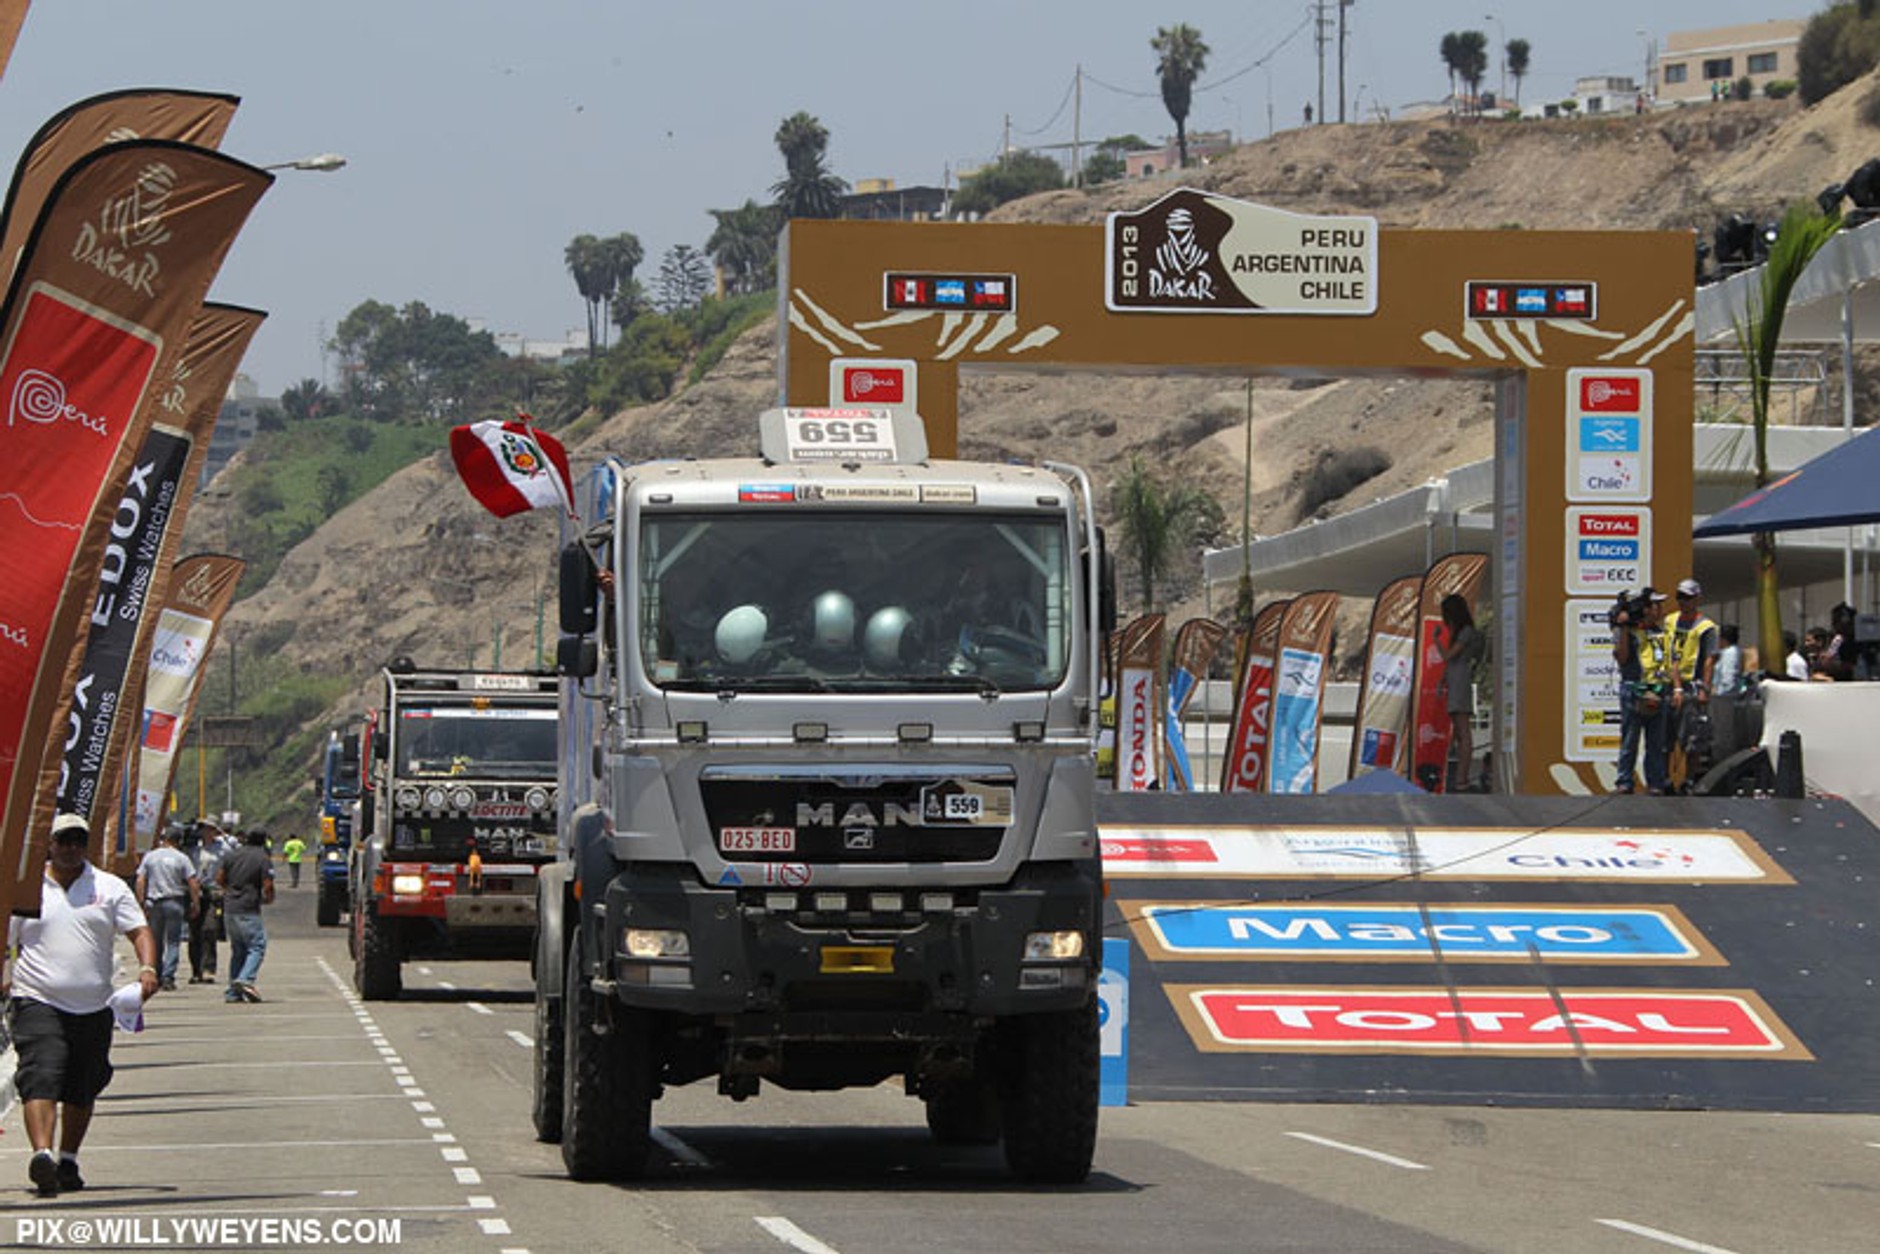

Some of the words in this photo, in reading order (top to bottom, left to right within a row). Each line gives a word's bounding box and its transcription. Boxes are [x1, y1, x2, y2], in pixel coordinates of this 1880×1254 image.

[1301, 230, 1365, 248] PERU
[72, 221, 159, 297] DAKAR
[1121, 225, 1138, 297] 2013
[1232, 254, 1365, 274] ARGENTINA
[1148, 269, 1216, 300] DAKAR
[1300, 281, 1364, 299] CHILE
[1583, 519, 1635, 532] TOTAL
[92, 462, 155, 626] EDOX
[119, 566, 149, 622] Swiss
[136, 480, 175, 559] Watches
[1585, 542, 1632, 556] Macro
[80, 691, 116, 772] Watches
[73, 778, 96, 820] wiss
[471, 804, 529, 816] LOCTITE
[949, 796, 979, 814] 559
[796, 802, 923, 826] MAN
[474, 825, 525, 838] MAN
[1507, 854, 1665, 869] Chile
[1227, 917, 1613, 943] Macro
[1235, 1004, 1731, 1034] TOTAL
